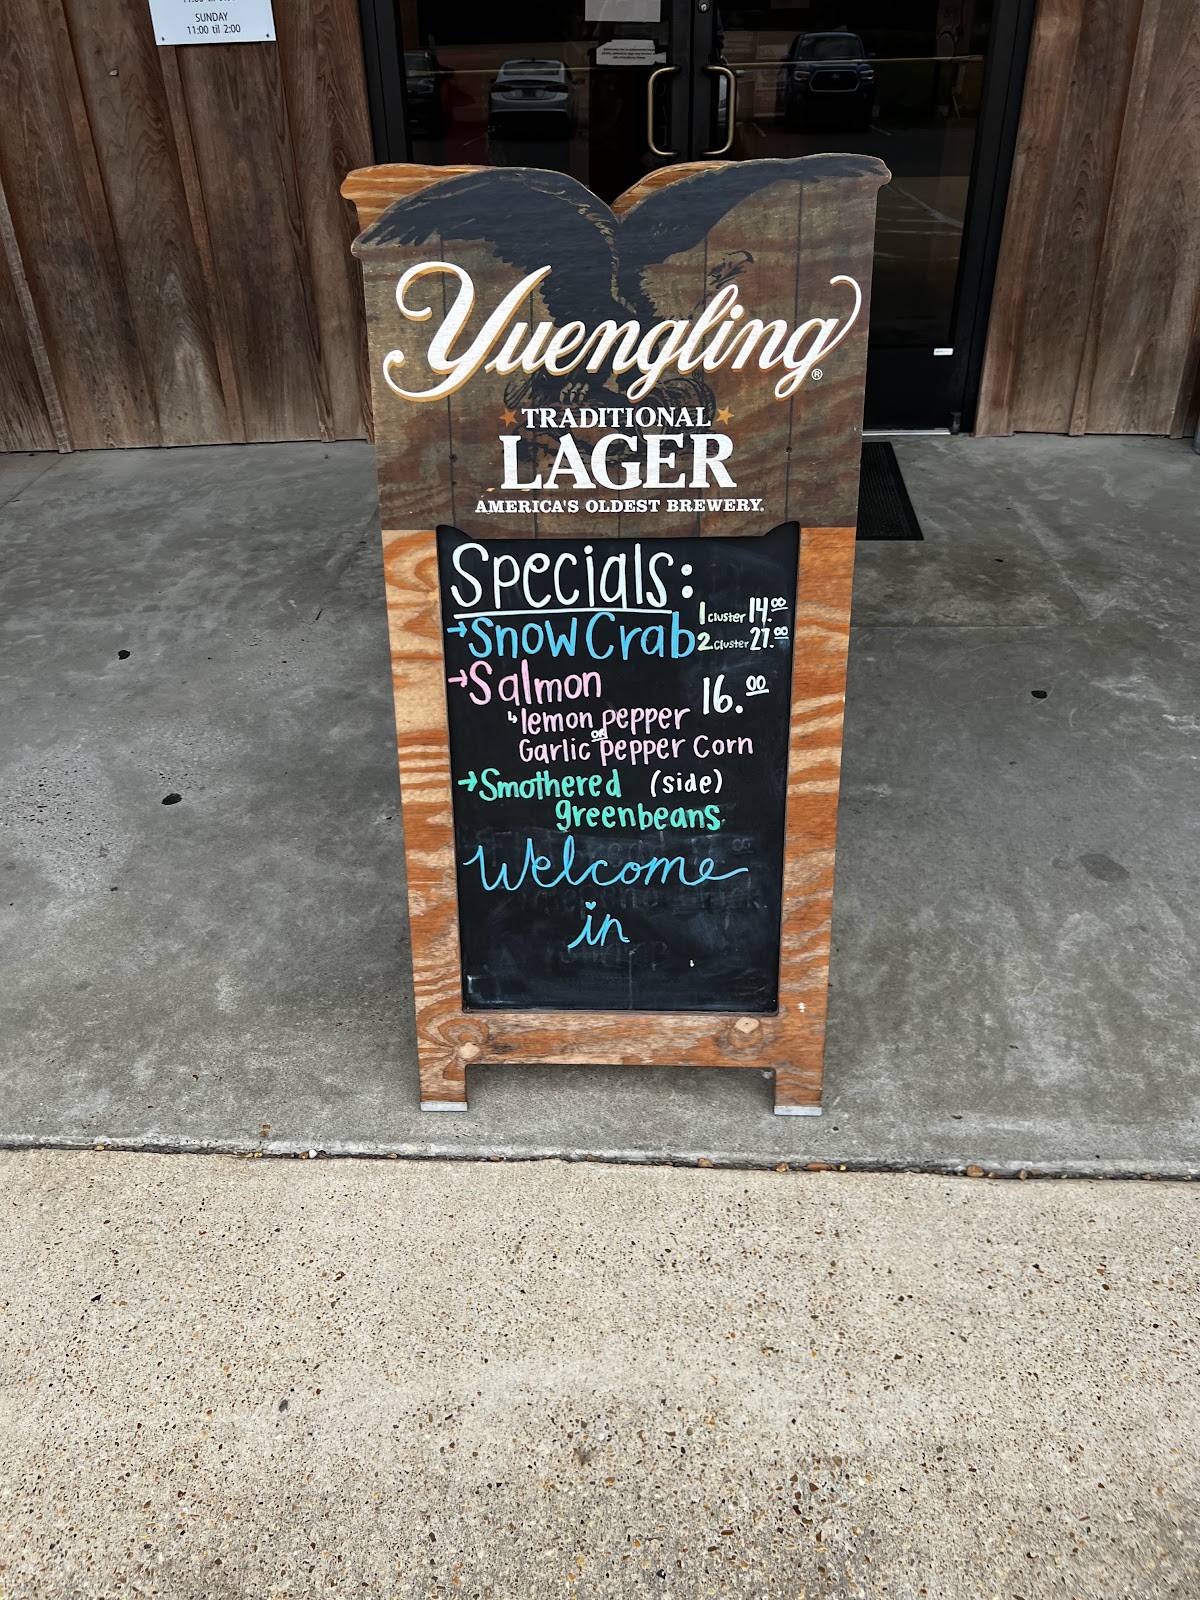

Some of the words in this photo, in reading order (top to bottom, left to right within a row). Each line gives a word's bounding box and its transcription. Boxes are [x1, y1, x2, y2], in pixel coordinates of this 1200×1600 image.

[187, 25, 209, 34] 11:00
[212, 24, 221, 34] til
[223, 24, 241, 33] 2:00
[195, 12, 228, 22] SUNDAY
[382, 261, 863, 403] Yuengling
[521, 407, 712, 430] TRADITIONAL
[500, 433, 736, 491] LAGER
[475, 499, 579, 514] AMERICA'S
[585, 499, 661, 514] OLDEST
[450, 543, 694, 610] Specials:
[699, 601, 706, 625] 1
[585, 611, 696, 661] Crab
[697, 631, 714, 652] 2
[468, 659, 602, 706] Salmon
[520, 708, 594, 735] lemon
[602, 706, 691, 740] pepper
[519, 738, 591, 764] Garlic
[600, 736, 686, 767] pepper
[693, 734, 754, 758] Corn
[478, 767, 622, 801] Smothered
[650, 768, 724, 797] (side)
[555, 799, 721, 831] greenbeans
[463, 835, 749, 891] Welcome
[567, 901, 632, 949] in
